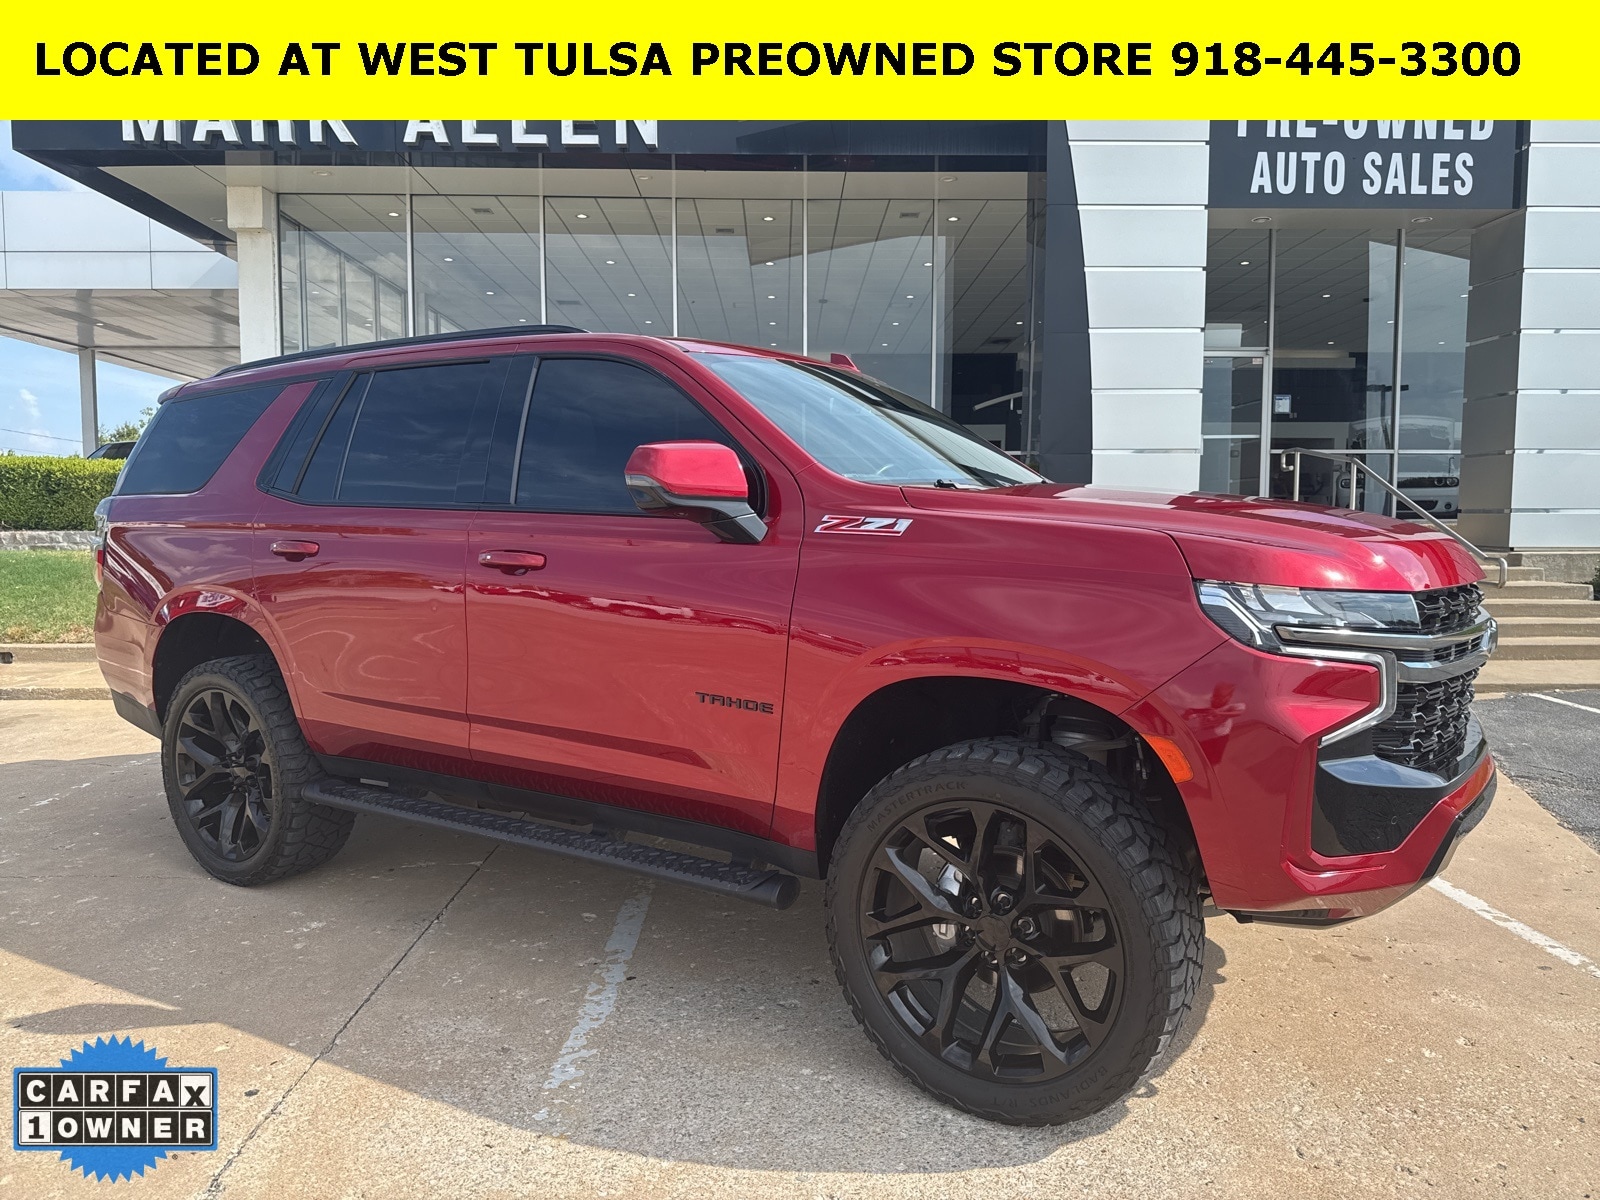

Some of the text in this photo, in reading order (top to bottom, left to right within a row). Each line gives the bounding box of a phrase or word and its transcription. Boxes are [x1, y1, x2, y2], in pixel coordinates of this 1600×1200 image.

[1249, 150, 1475, 196] AUTO SALES
[813, 514, 914, 537] Z71
[694, 691, 774, 715] TAHOE
[865, 780, 968, 833] MASTERTRACK
[1028, 1065, 1109, 1109] BADLANDS
